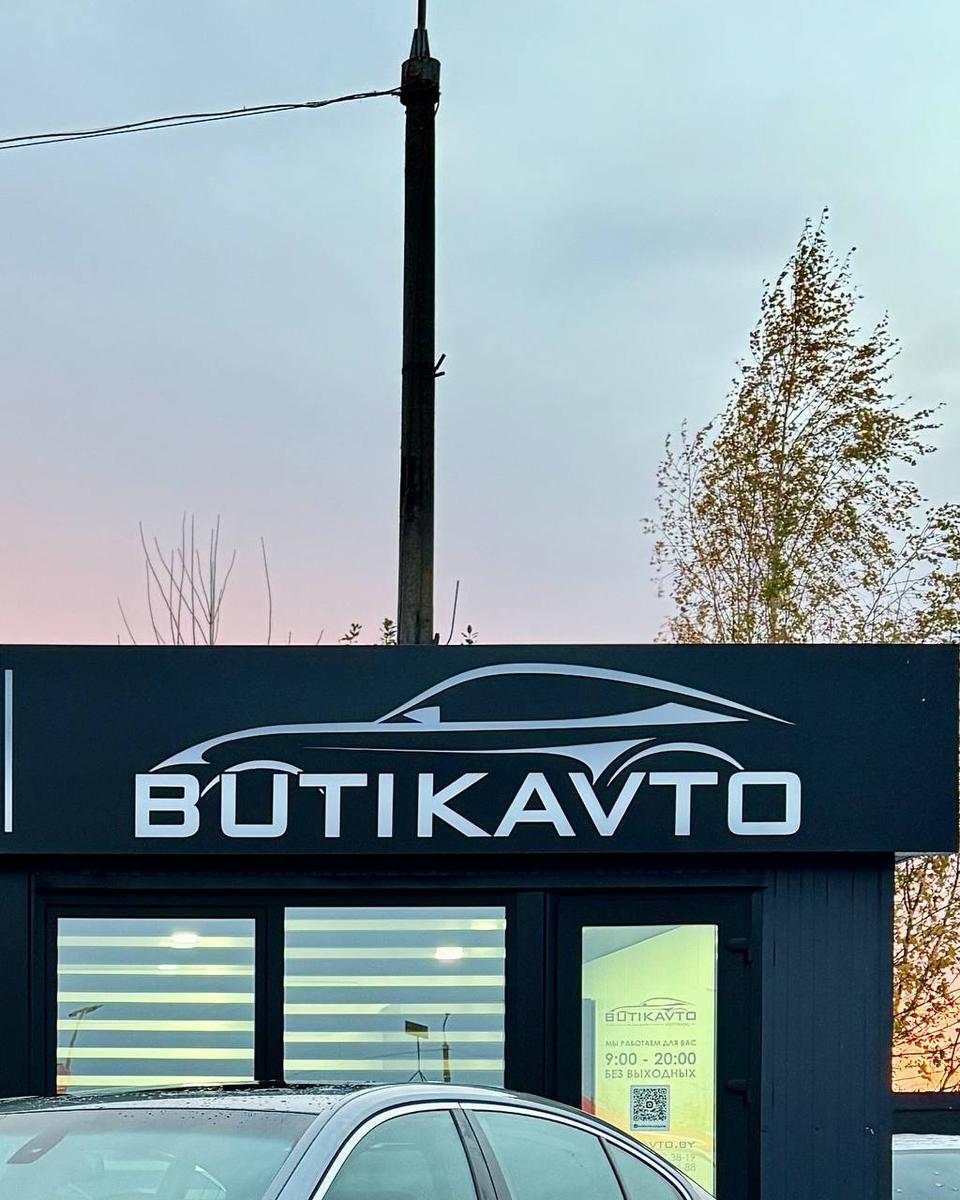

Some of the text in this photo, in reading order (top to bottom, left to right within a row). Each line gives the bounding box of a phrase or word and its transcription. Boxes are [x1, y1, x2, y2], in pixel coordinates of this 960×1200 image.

[134, 770, 803, 840] BUTIKAVTO
[605, 1011, 697, 1022] BUTIKAVTO
[605, 1052, 637, 1066] 9:00
[654, 1052, 697, 1066] 20:00
[605, 1069, 697, 1079] БЕЗ ВЫХОДНЫХ
[649, 1141, 697, 1149] VTO.BY
